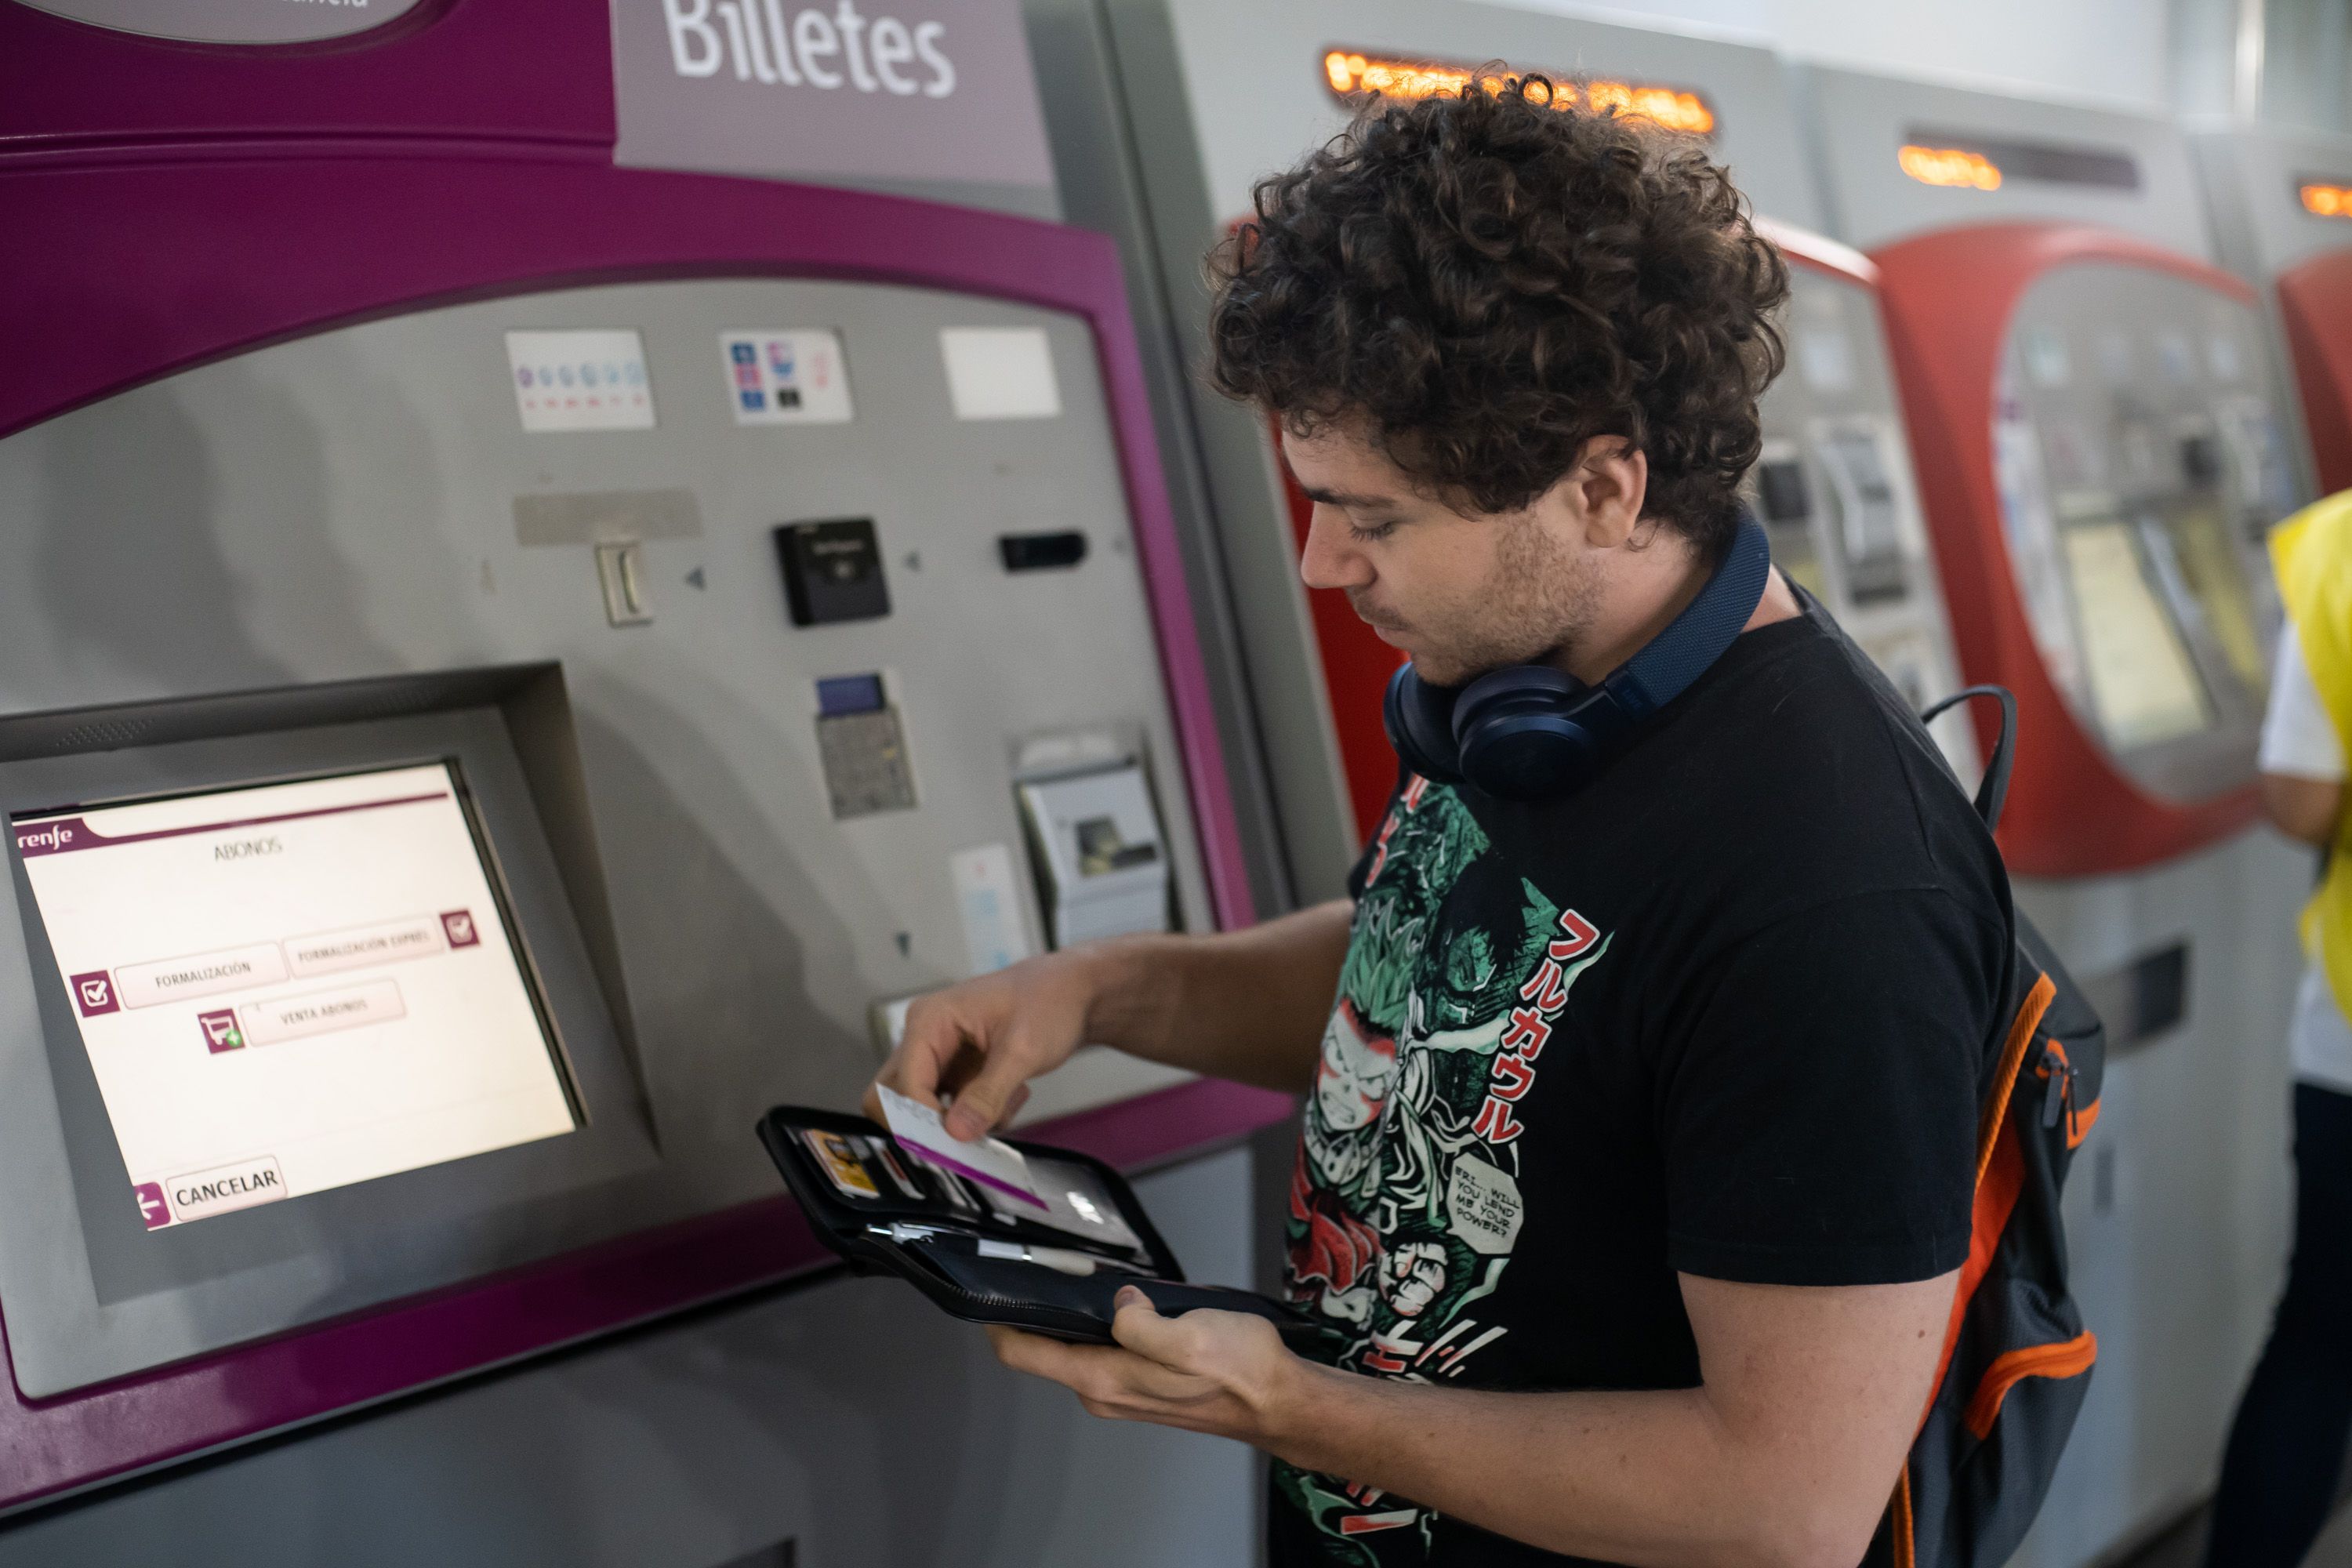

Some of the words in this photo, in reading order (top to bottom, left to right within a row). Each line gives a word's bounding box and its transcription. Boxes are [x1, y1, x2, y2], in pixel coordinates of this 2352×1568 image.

[663, 0, 956, 98] Billetes
[17, 825, 73, 851] renfe
[215, 836, 283, 862] ABONOS
[155, 961, 251, 988] FORMALIZACIÓN
[280, 1008, 318, 1025] VENTA
[321, 999, 368, 1017] ABONOS
[1471, 908, 1600, 1144] フルカウル
[176, 1170, 278, 1206] CANCELAR
[1458, 1181, 1480, 1199] YOU
[1485, 1196, 1515, 1217] LEND
[1491, 1188, 1519, 1209] WILL
[1457, 1207, 1507, 1237] POWER?
[1480, 1205, 1510, 1229] YOUR
